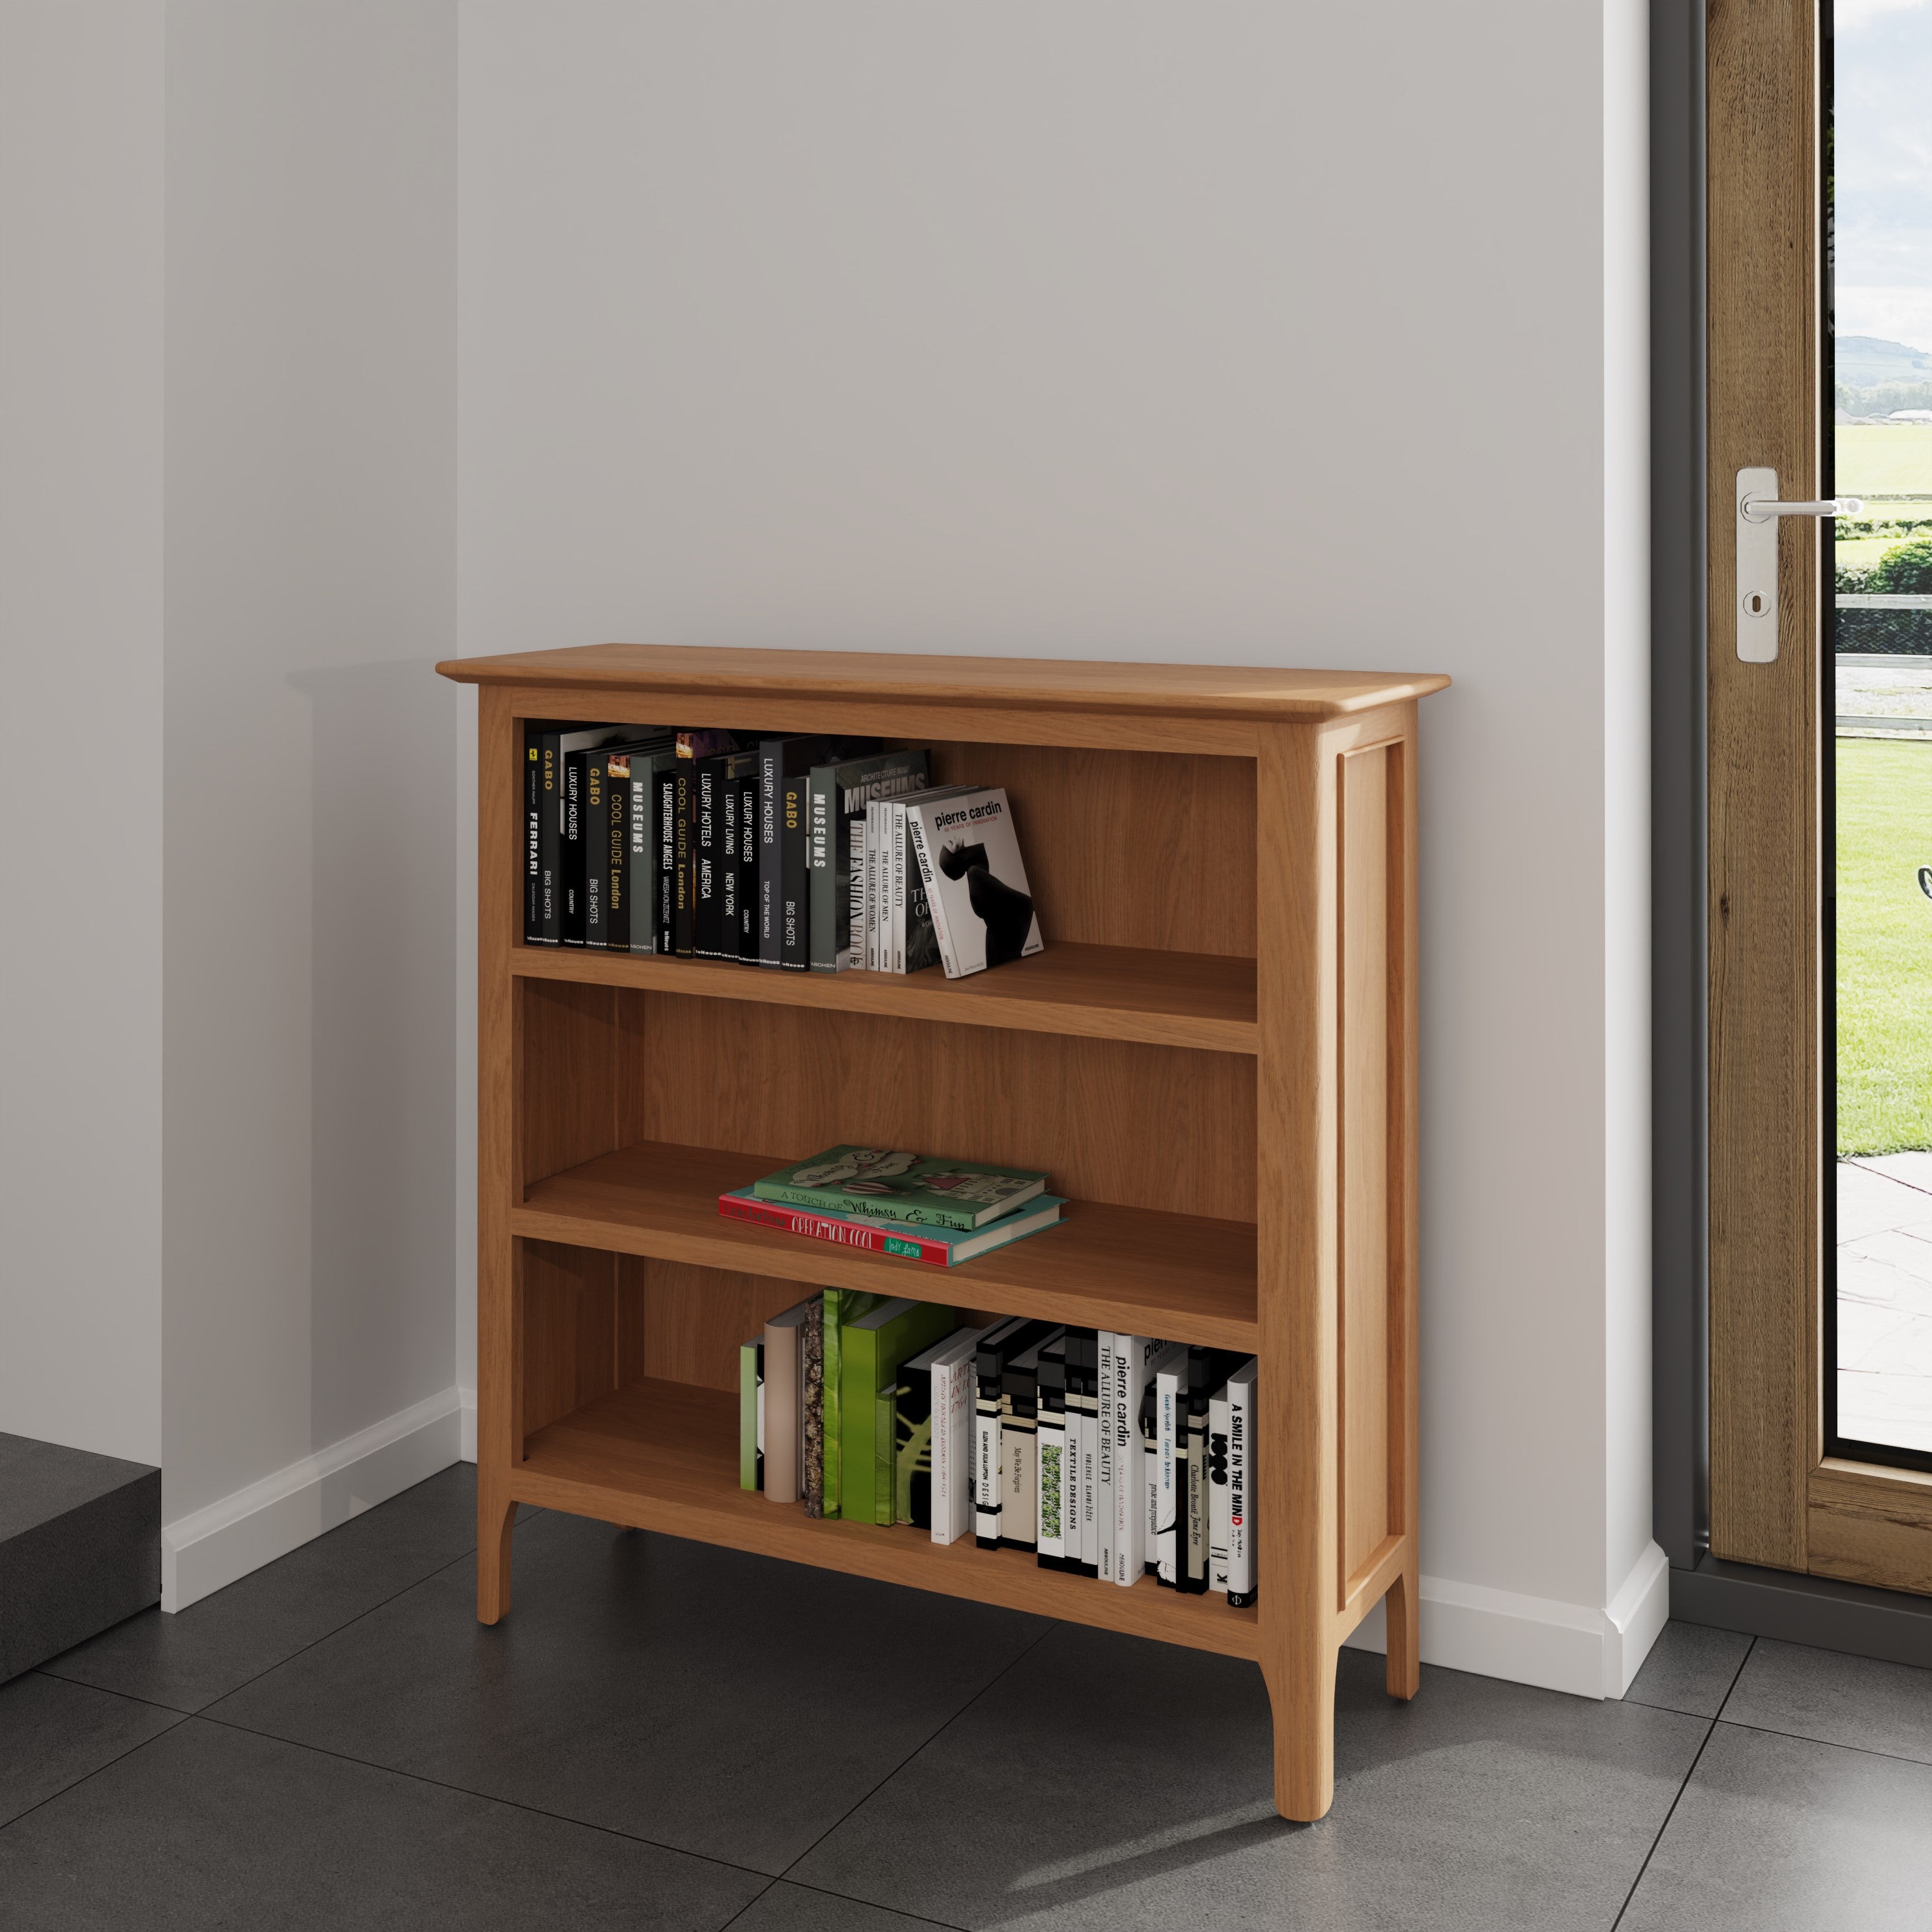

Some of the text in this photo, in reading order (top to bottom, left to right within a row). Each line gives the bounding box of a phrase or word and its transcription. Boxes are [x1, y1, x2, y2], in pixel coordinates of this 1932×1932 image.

[545, 750, 553, 790] GABO
[590, 768, 600, 805] GABO
[860, 768, 896, 783] ARCHITECTURE
[569, 767, 578, 840] LUXURY HOUSES
[678, 777, 687, 813] COOL
[764, 758, 773, 844] LUXURY HOUSES
[786, 791, 797, 829] GABO
[844, 773, 925, 815] MUSEUMS
[632, 781, 643, 853] MUSEUMS
[663, 782, 673, 870] SLAUGHTERHOUSE ANGELS
[743, 791, 753, 862] LUXURY HOUSES
[813, 793, 826, 867] MUSEUMS
[934, 801, 1002, 831] pierre cardin
[973, 815, 998, 826] INNOVATION
[611, 794, 622, 909] COOL GUIDE London
[678, 819, 687, 858] GUIDE
[701, 773, 712, 899] LUXURY HOTELS AMERICA
[725, 794, 734, 916] LUXURY LIVING NEW YORK
[850, 823, 864, 853] THE
[909, 821, 934, 883] pierre cardin
[895, 863, 903, 875] OF
[589, 878, 598, 924] BIG SHOTS
[764, 894, 770, 903] OF
[850, 857, 864, 921] FASHION
[869, 893, 876, 904] OF
[882, 895, 889, 905] OF
[911, 887, 927, 902] TH
[786, 901, 795, 946] BIG SHOTS
[790, 1192, 826, 1208] TOUCH
[936, 1213, 965, 1229] Fun
[791, 1216, 846, 1243] OPERATION
[1144, 1338, 1167, 1366] pier
[1115, 1356, 1130, 1398] pierre
[1101, 1346, 1111, 1486] THE ALLURE OF BEAUTY
[1117, 1403, 1130, 1446] cardin
[1231, 1403, 1242, 1412] A
[1231, 1416, 1242, 1451] SMILE
[1231, 1454, 1242, 1466] IN
[1231, 1470, 1242, 1491] THE
[1191, 1464, 1201, 1546] Charlotte Brontë Jane Eyre
[1231, 1493, 1243, 1526] MIND
